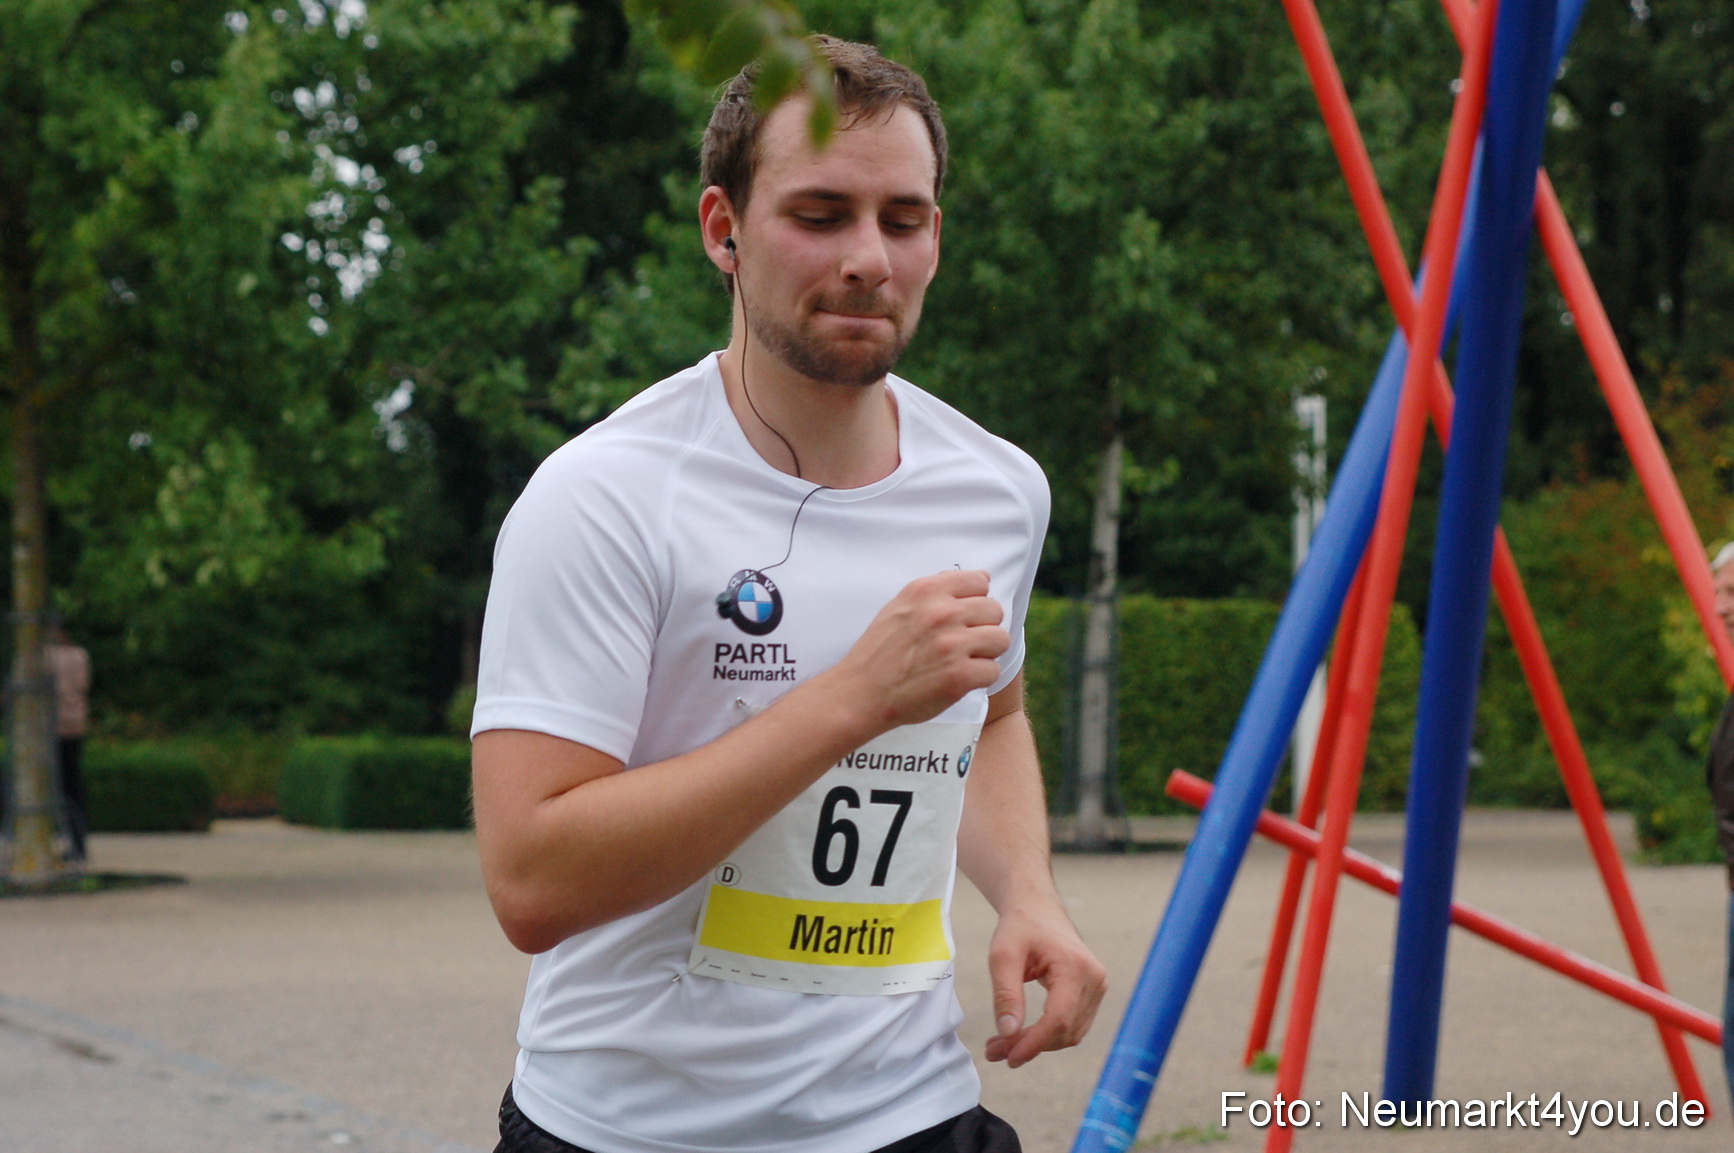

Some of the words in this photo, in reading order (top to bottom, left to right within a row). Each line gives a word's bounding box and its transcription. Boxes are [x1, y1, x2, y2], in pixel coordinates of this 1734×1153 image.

[714, 643, 796, 664] PARTL
[713, 665, 796, 681] Neumarkt
[811, 785, 914, 887] 67
[721, 866, 734, 883] D
[789, 914, 895, 956] Martin
